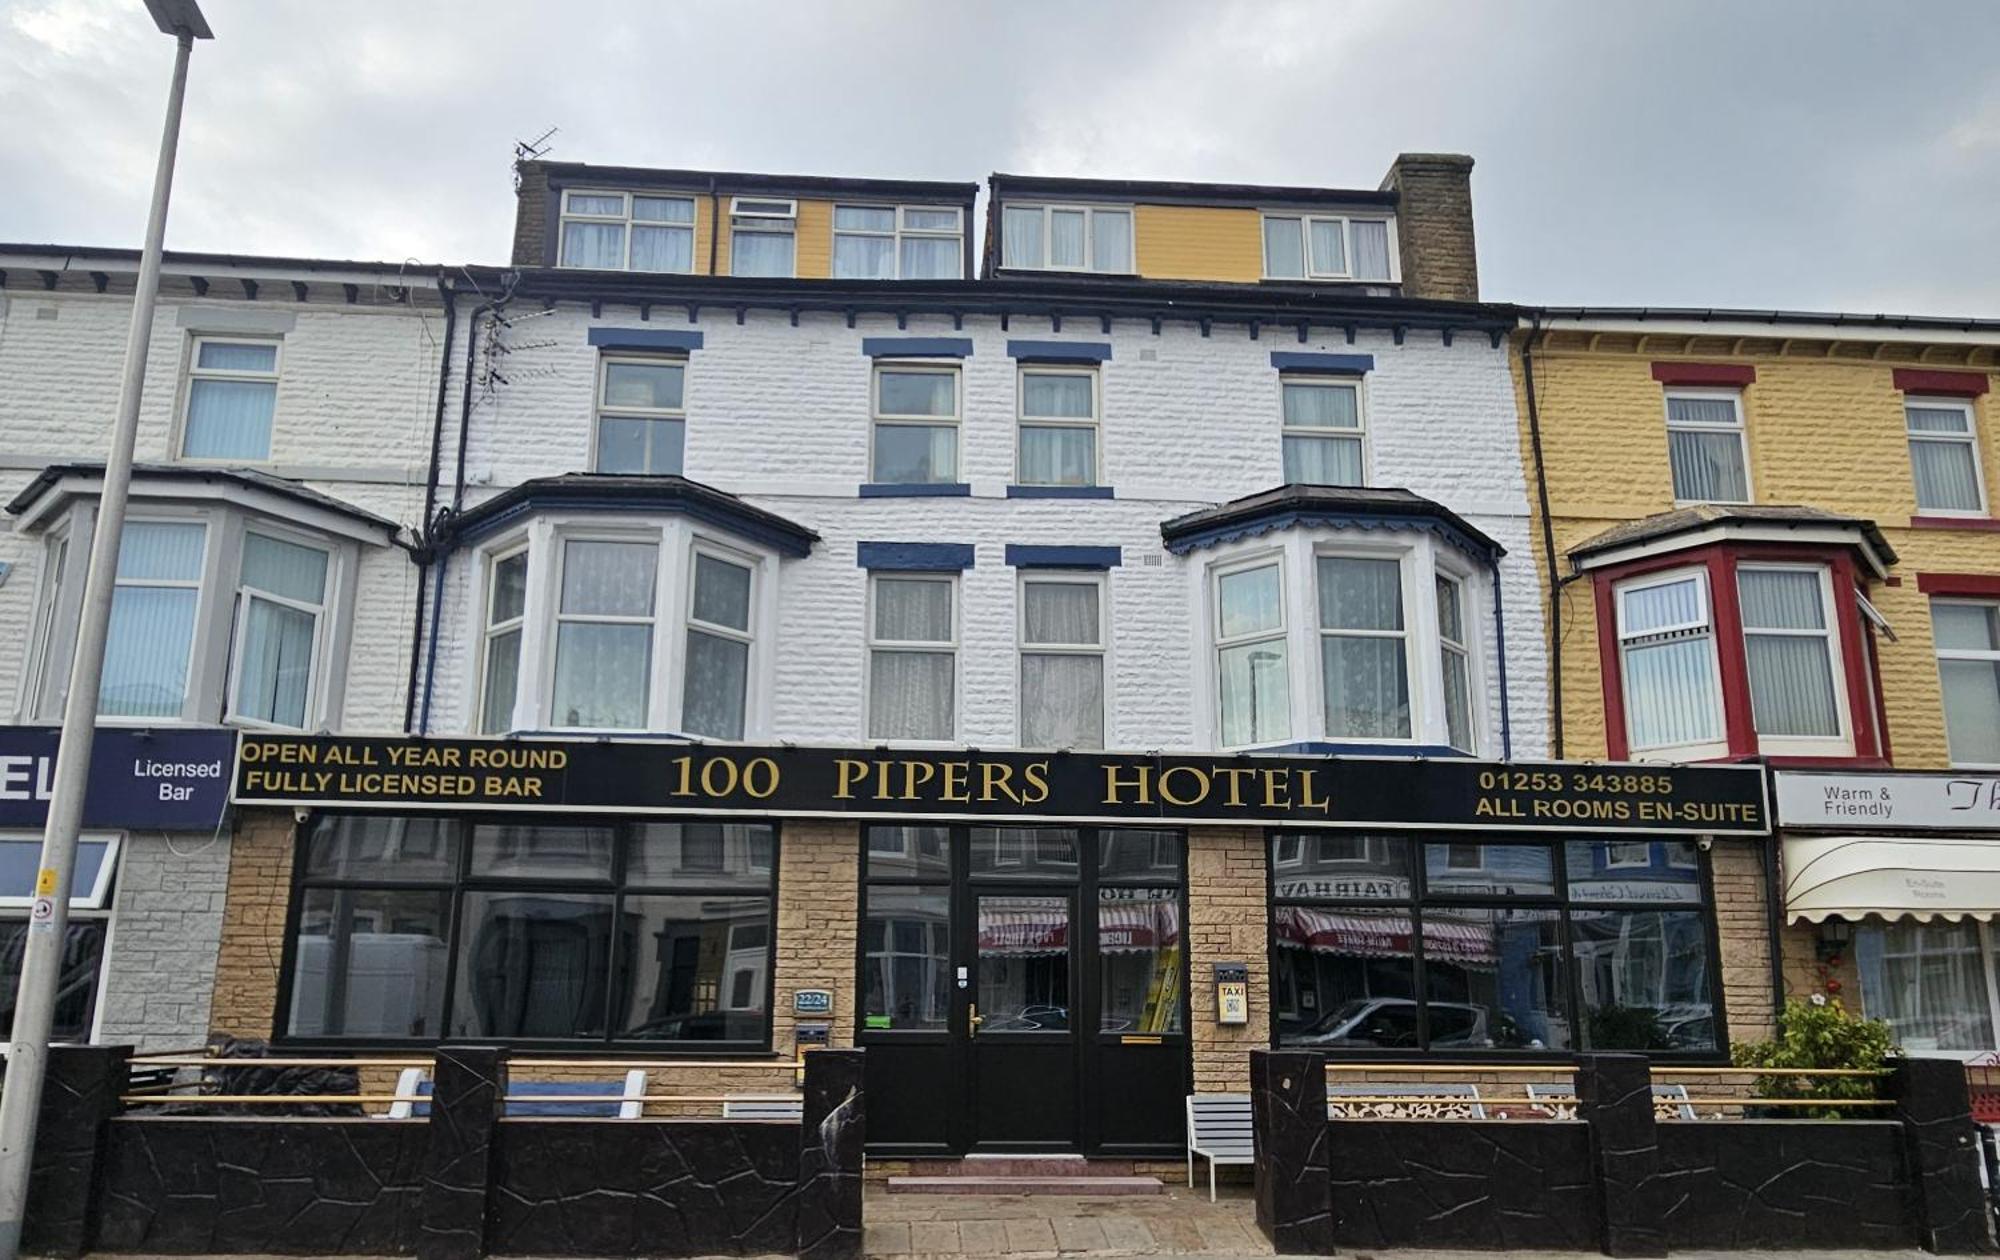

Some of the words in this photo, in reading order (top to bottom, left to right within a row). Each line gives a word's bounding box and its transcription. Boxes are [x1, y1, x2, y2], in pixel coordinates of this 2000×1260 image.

[241, 743, 317, 763] OPEN
[323, 745, 379, 765] ALL
[386, 746, 461, 767] YEAR
[469, 748, 568, 769] ROUND
[134, 759, 221, 778] Licensed
[159, 783, 195, 801] Bar
[246, 771, 333, 792] FULLY
[339, 773, 476, 796] LICENSED
[484, 776, 543, 797] BAR
[669, 756, 781, 798] 100
[831, 759, 1050, 806] PIPERS
[1101, 764, 1330, 815] HOTEL
[1479, 771, 1563, 791] 01253
[1573, 773, 1673, 795] 343885
[1824, 786, 1873, 800] Warm
[1879, 786, 1891, 800] &
[1475, 797, 1526, 817] ALL
[1533, 799, 1631, 819] ROOMS
[1639, 801, 1758, 823] EN-SUITE
[1824, 801, 1893, 819] Friendly
[1222, 987, 1244, 997] TAXI
